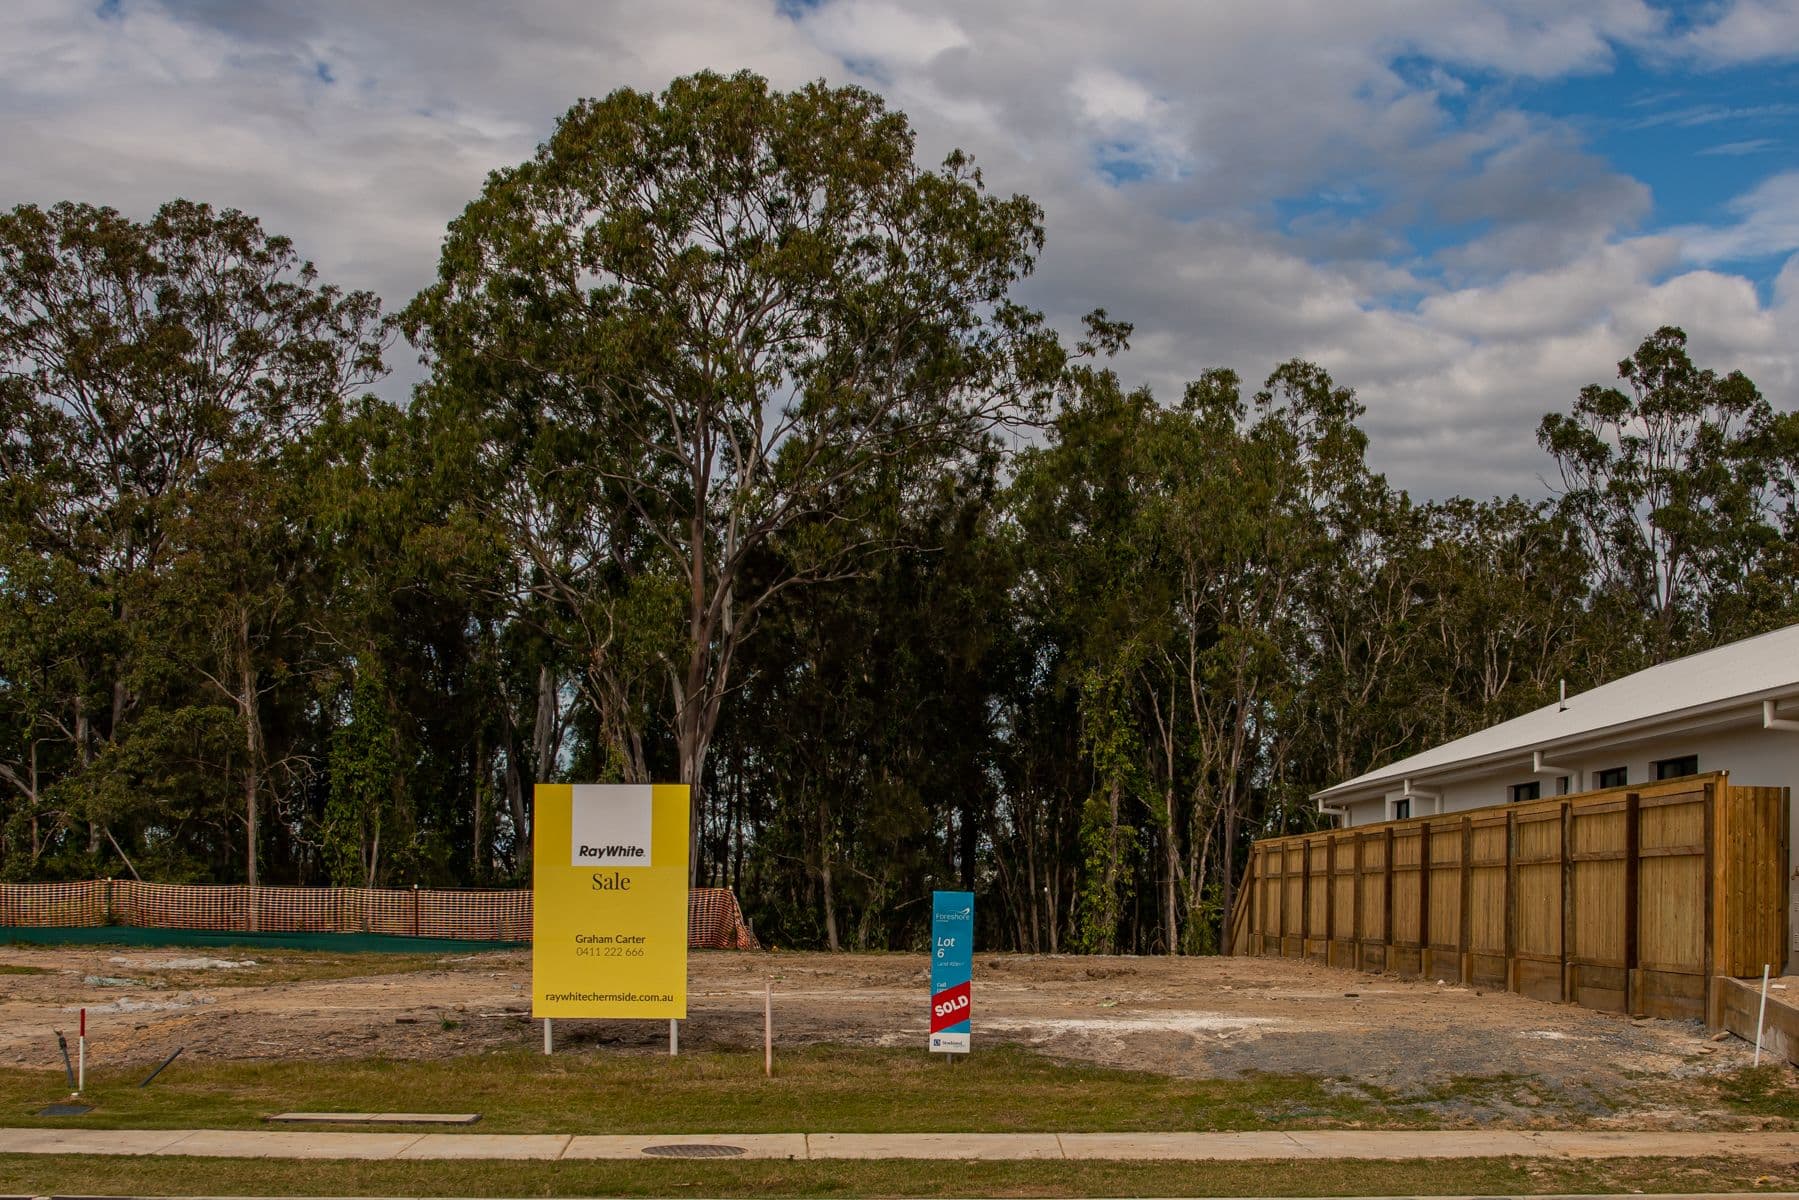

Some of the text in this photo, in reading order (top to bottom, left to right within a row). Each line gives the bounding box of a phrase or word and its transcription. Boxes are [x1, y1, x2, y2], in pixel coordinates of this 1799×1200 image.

[579, 845, 645, 858] RayWhite
[592, 872, 630, 890] Sale
[936, 912, 970, 920] Foreshore
[575, 934, 646, 944] Graham Carter
[937, 937, 955, 947] Lot
[576, 947, 644, 956] 0411 222 666
[937, 948, 945, 958] 6
[545, 992, 673, 1002] raywhitechermside.com.au
[934, 995, 968, 1017] SOLD
